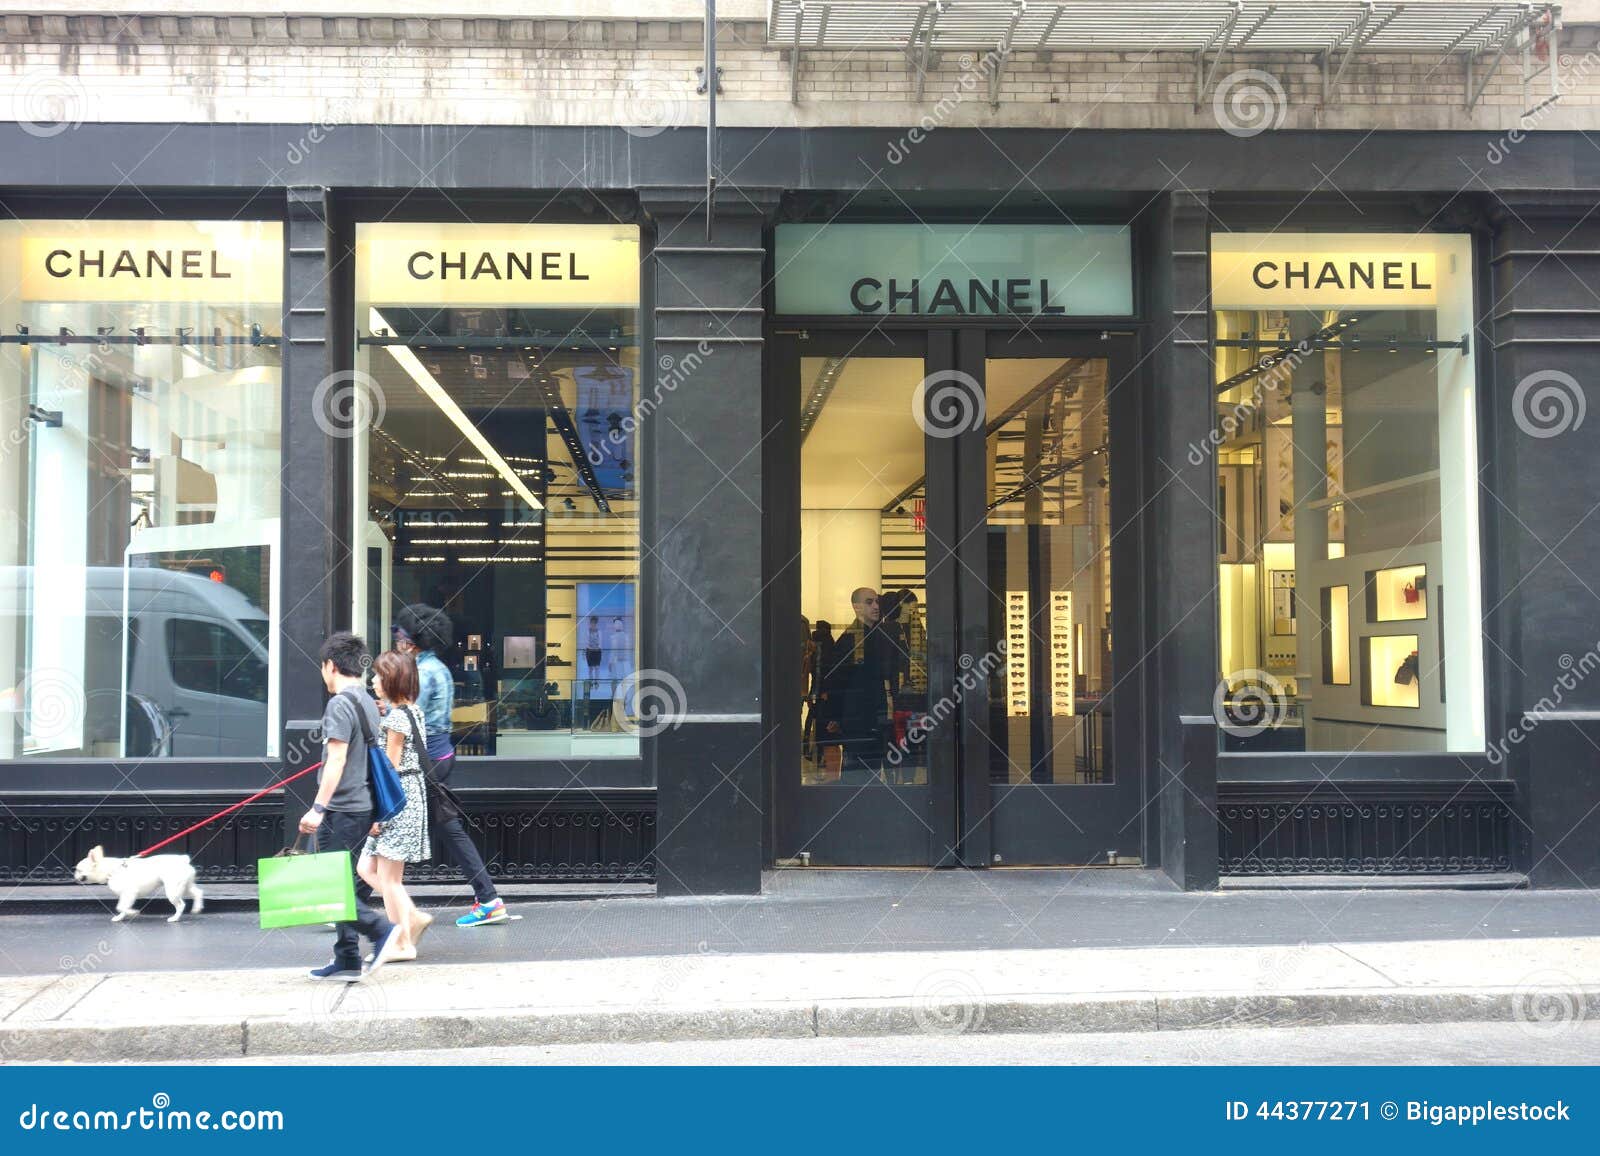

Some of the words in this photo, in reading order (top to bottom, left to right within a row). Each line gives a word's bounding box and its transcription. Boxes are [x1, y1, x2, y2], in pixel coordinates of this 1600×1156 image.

[45, 249, 232, 279] CHANEL
[407, 250, 590, 281] CHANEL
[1252, 261, 1432, 290] CHANEL
[850, 277, 1066, 314] CHANEL
